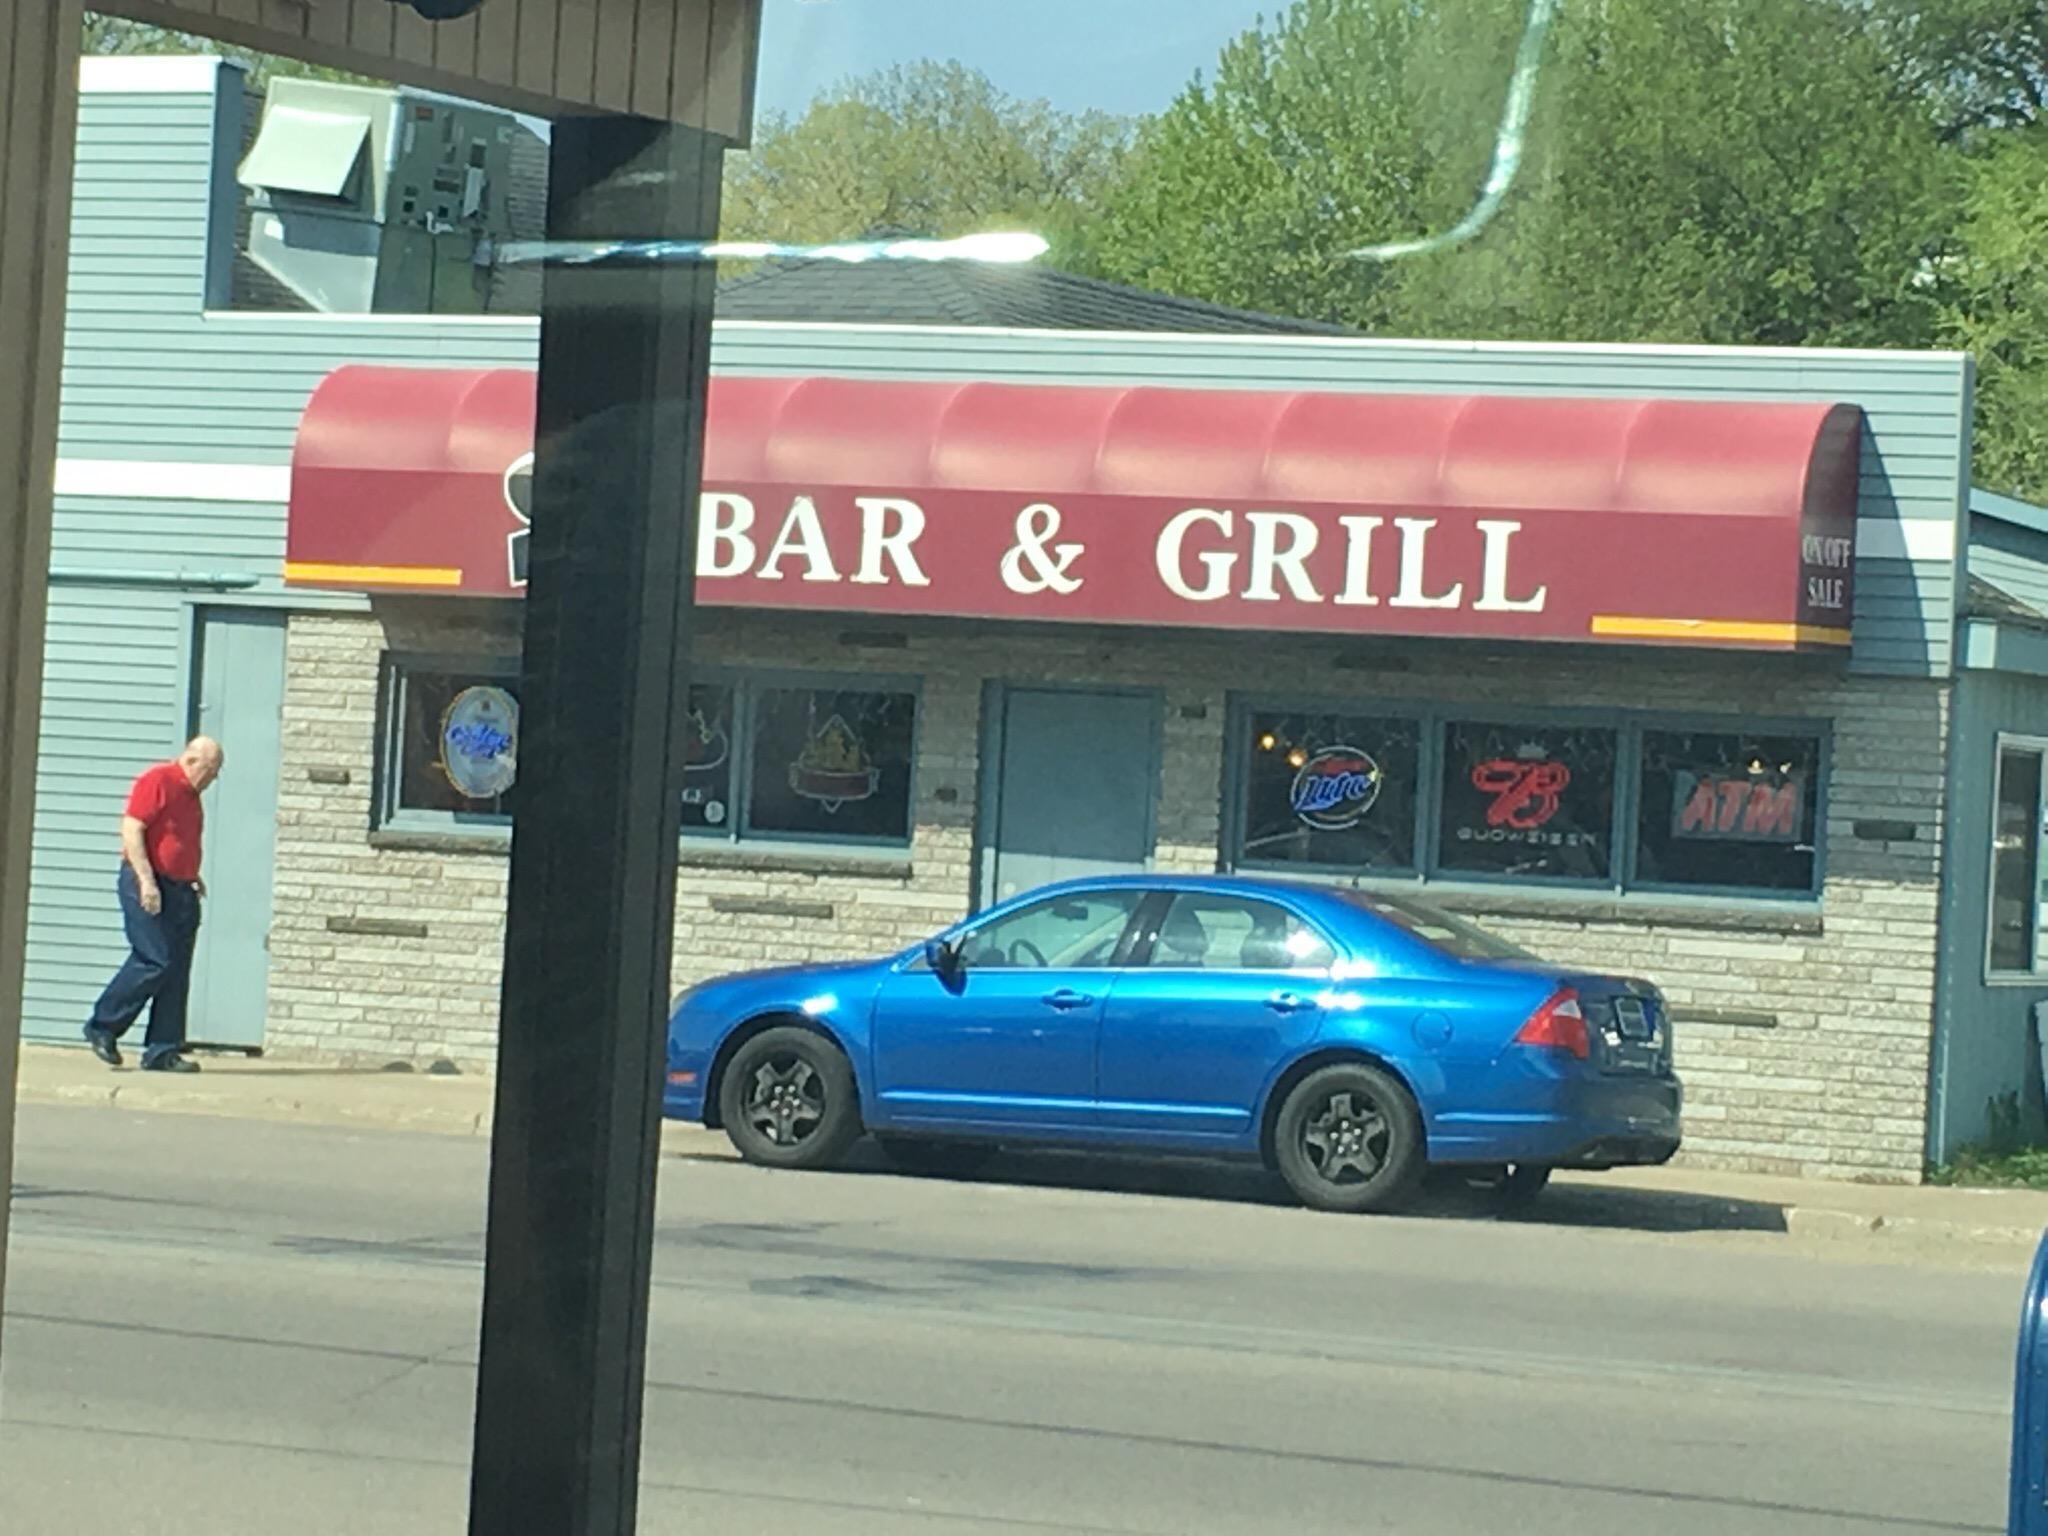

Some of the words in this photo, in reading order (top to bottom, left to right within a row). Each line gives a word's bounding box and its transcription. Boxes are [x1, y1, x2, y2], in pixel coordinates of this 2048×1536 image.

[695, 492, 931, 586] BAR
[1000, 503, 1085, 595] &
[1156, 508, 1547, 613] GRILL
[1681, 777, 1797, 836] ATM
